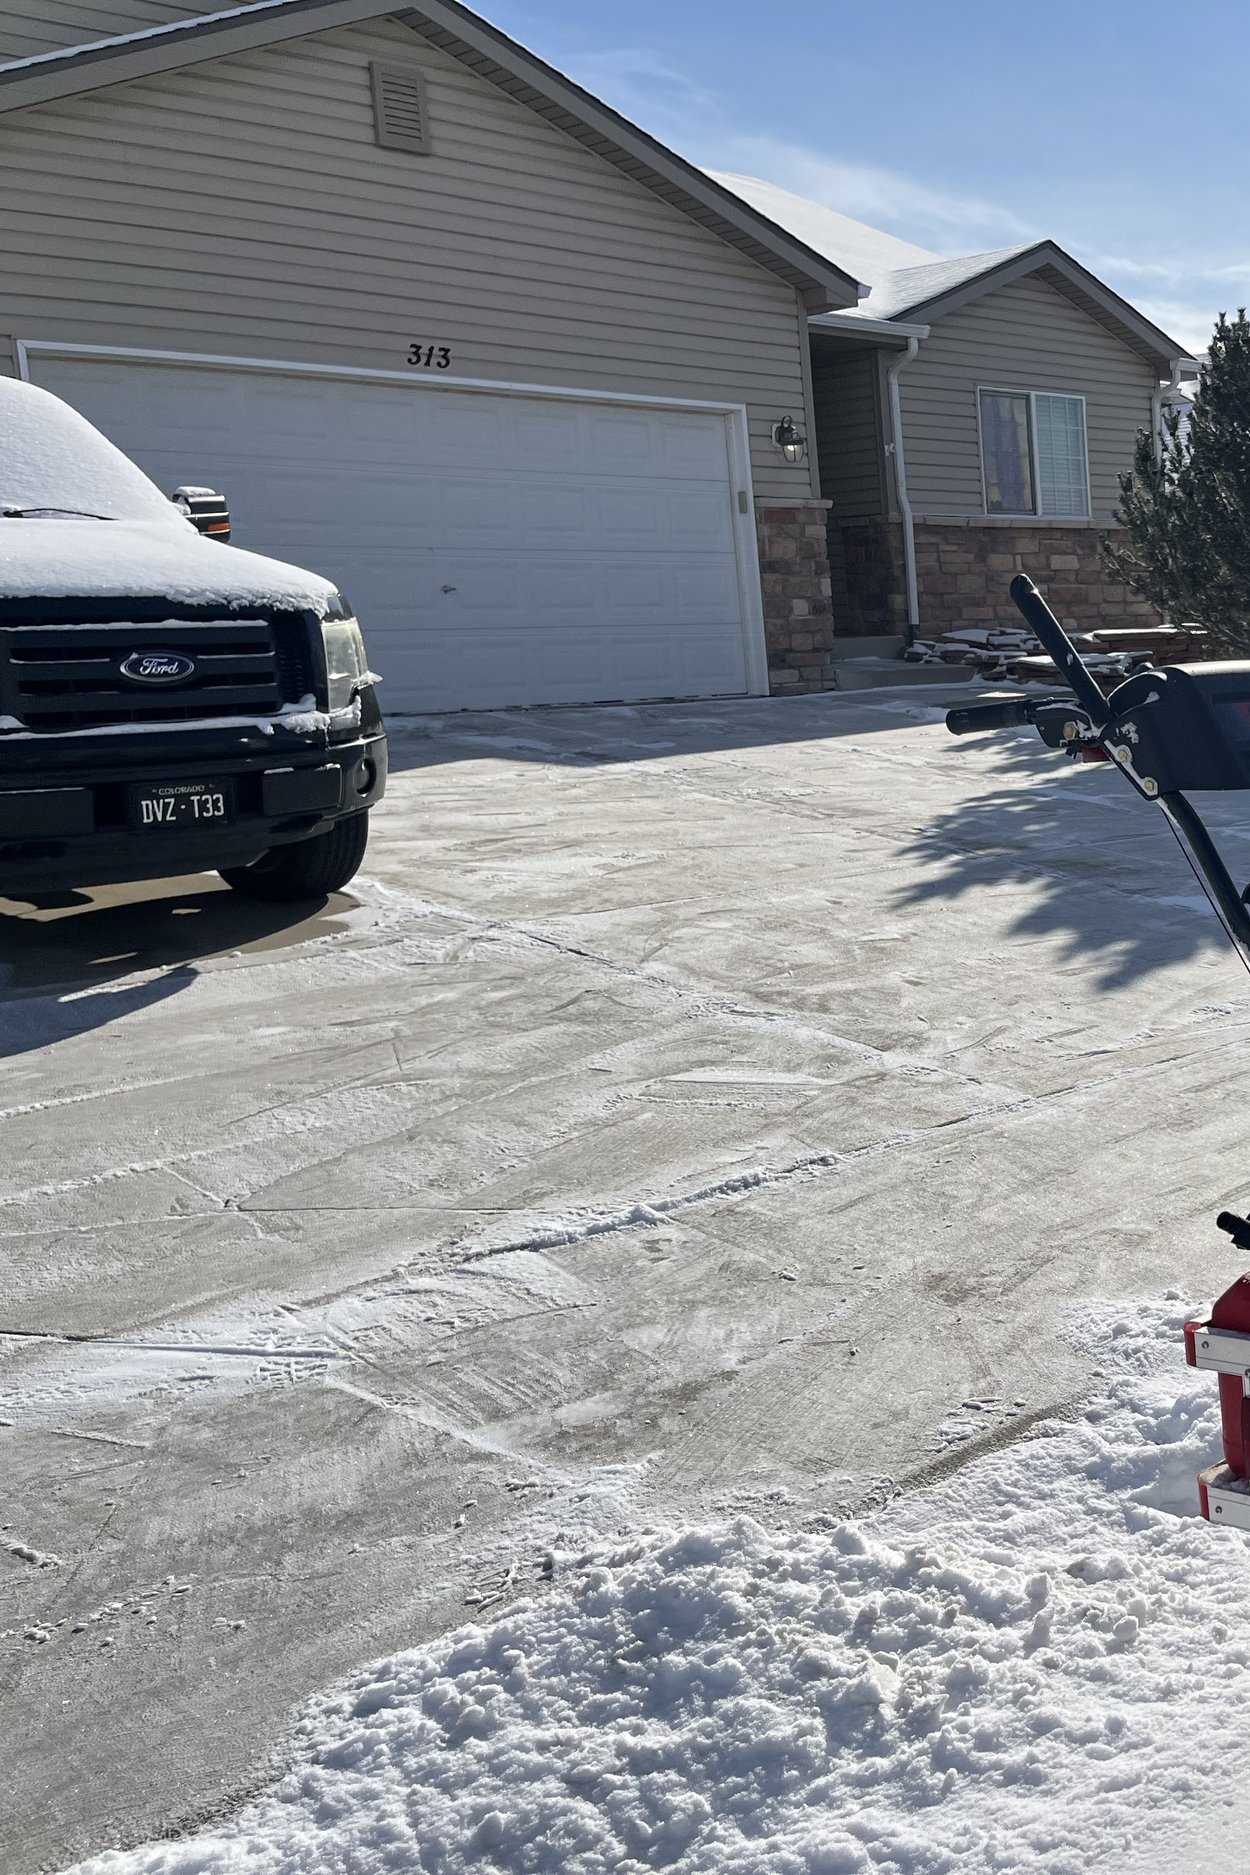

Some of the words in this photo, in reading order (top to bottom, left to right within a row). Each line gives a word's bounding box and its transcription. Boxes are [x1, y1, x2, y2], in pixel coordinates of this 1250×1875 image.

[407, 343, 451, 369] 313
[139, 657, 180, 676] Ford
[158, 784, 206, 796] COLORADO
